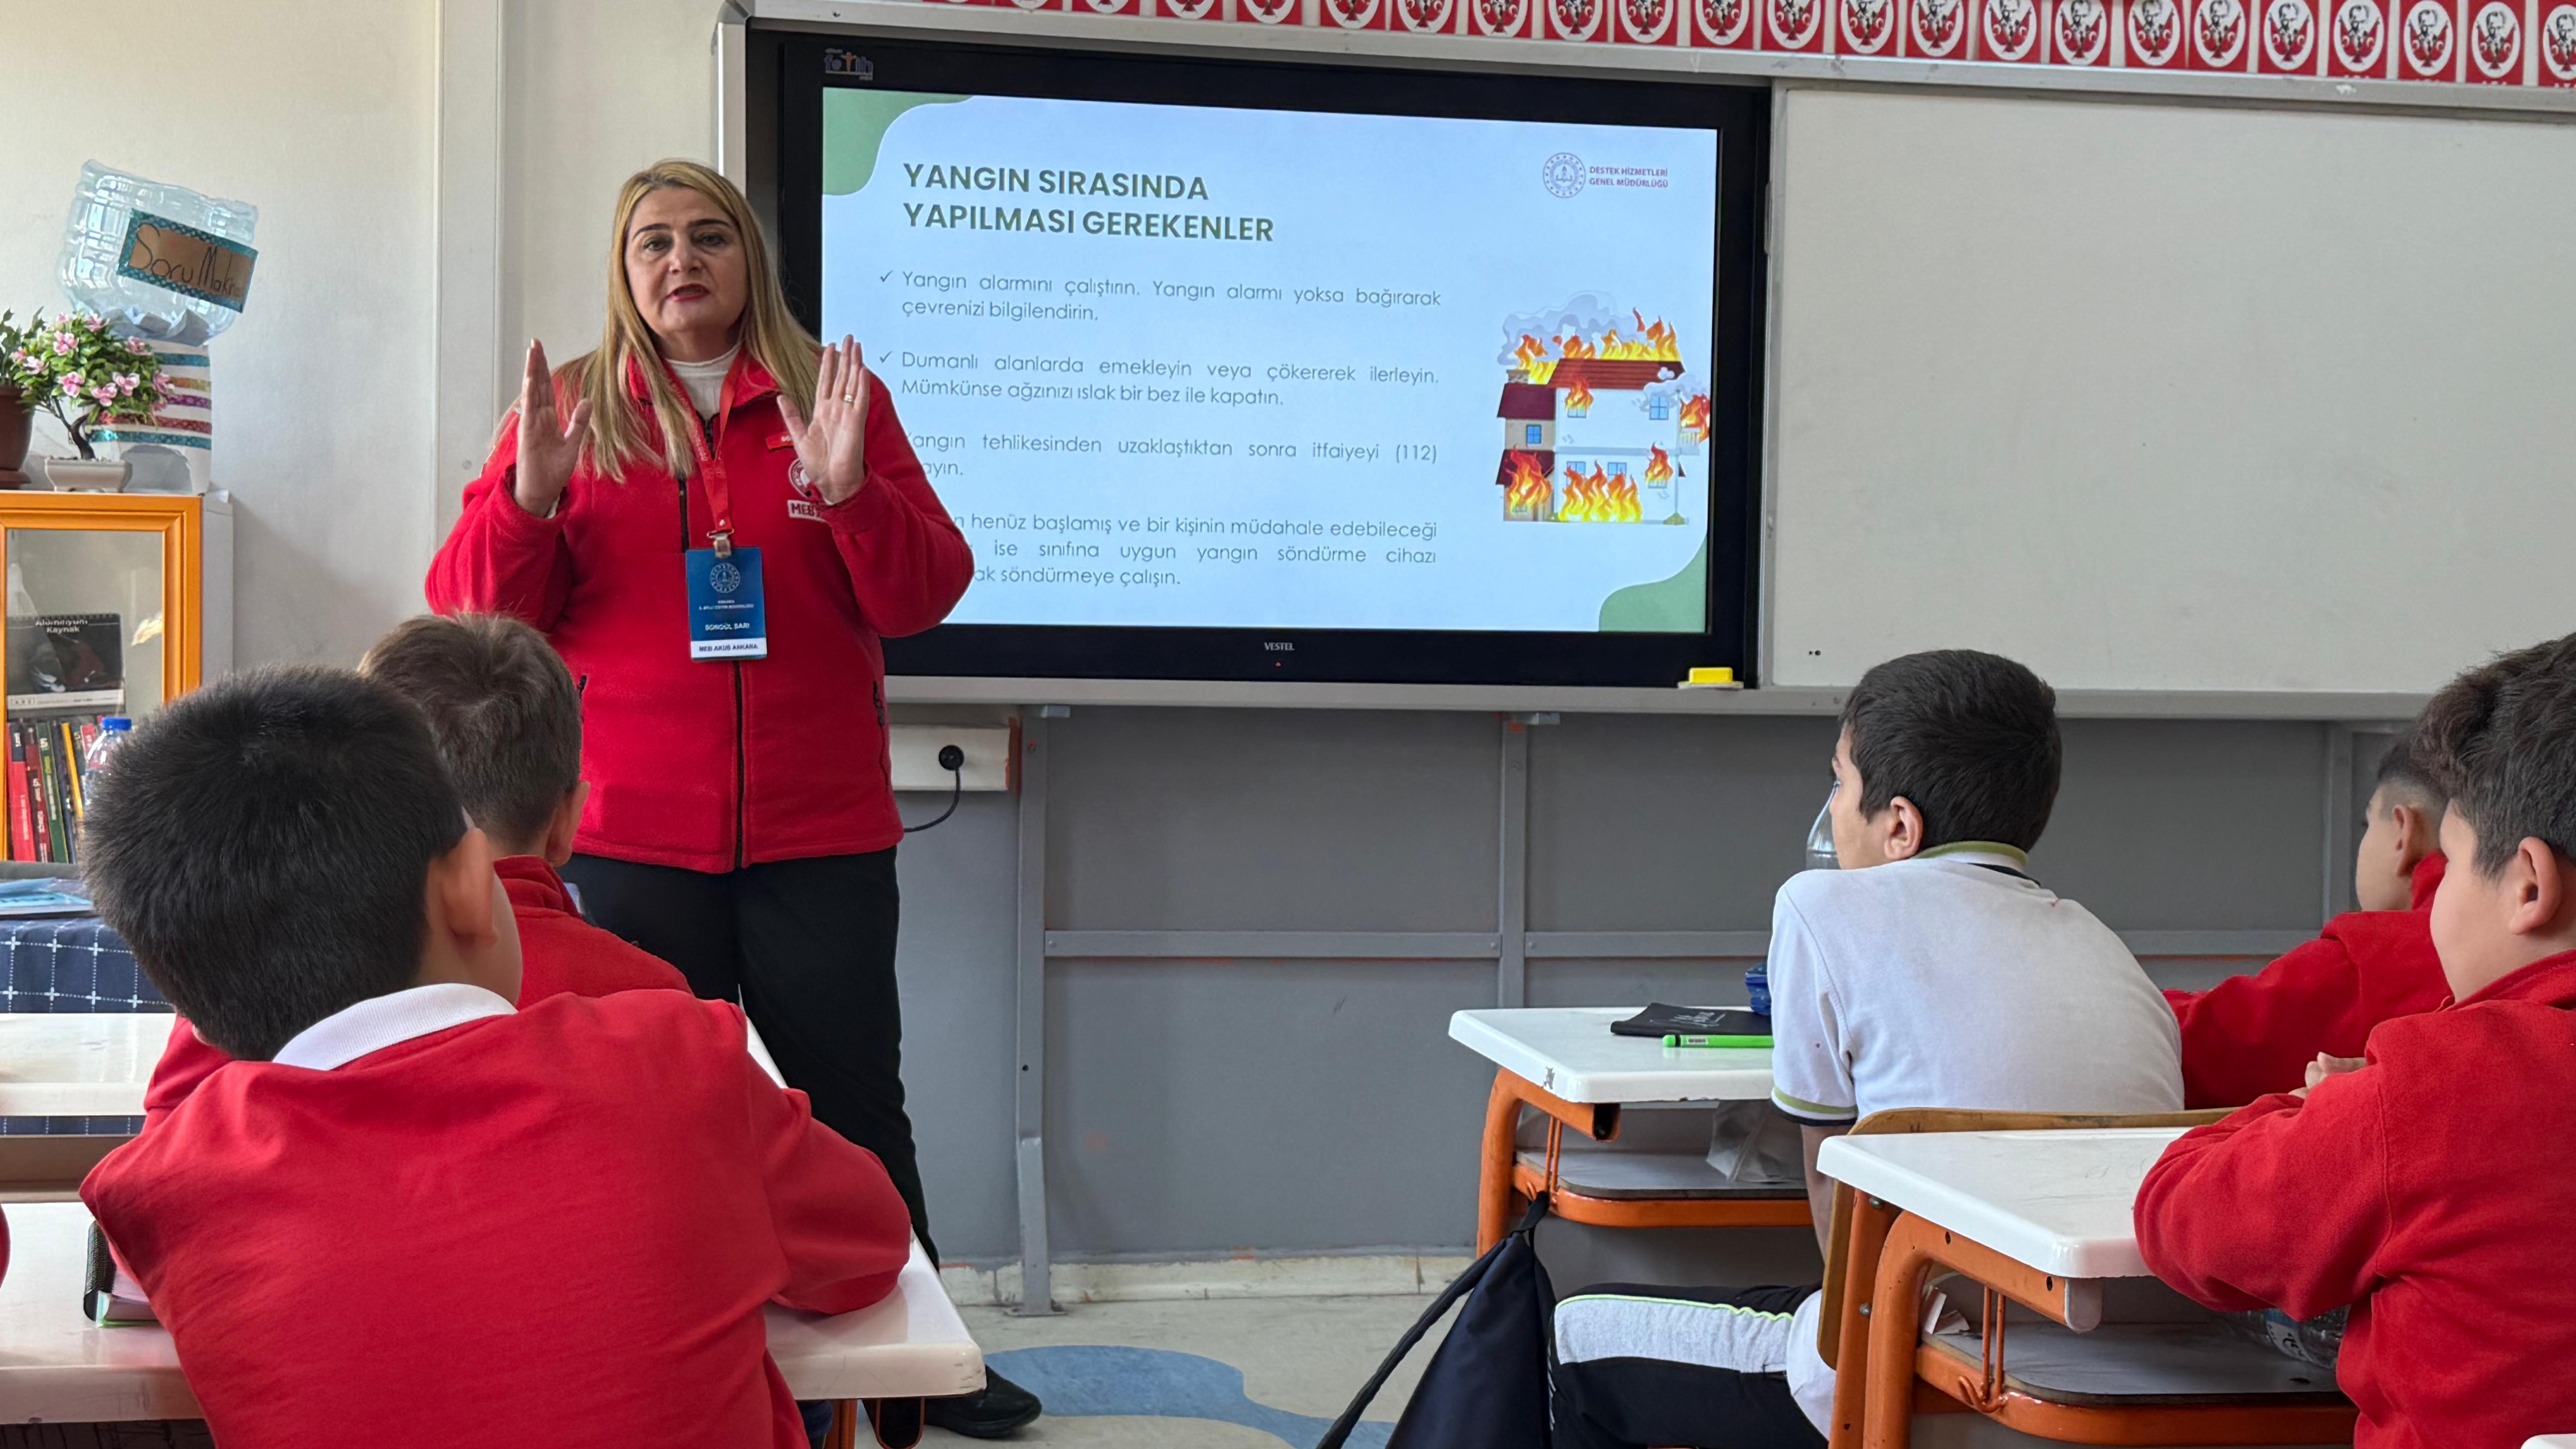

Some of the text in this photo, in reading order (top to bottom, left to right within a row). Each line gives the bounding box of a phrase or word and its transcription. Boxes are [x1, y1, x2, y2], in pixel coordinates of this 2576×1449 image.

[903, 163, 1209, 201] YANGIN SIRASINDA
[1589, 166, 1668, 177] DESTEK HİZMETLERİ
[1589, 178, 1668, 188] GENEL MÜDÜRLÜĞÜ
[903, 202, 1273, 242] YAPILMASI GEREKENLER
[128, 222, 193, 283] Soru
[903, 271, 1441, 308] Yangın alarmını çalıştırın. Yangın alarmı yoksa bağırarak
[902, 300, 1098, 322] çevrenizi bilgilendirin.
[902, 351, 1438, 386] Dumanlı alanlarda emekleyin veya çökererek ilerleyin.
[902, 379, 1283, 407] Mümkünse ağzınızı ıslak bir bez ile kapatın.
[909, 432, 1436, 464] angın tehlikesinden uzaklaştıktan sonra itfaiyeyi (112)
[922, 462, 963, 478] ayın.
[972, 513, 1026, 530] henüz
[1033, 514, 1111, 535] başlamış
[1118, 520, 1140, 532] ve
[1147, 517, 1170, 532] bir
[1176, 517, 1225, 536] kişinin
[1231, 519, 1324, 535] müdahale
[1330, 521, 1437, 541] edebileceği
[995, 539, 1436, 564] ise sınıfına uygun yangın söndürme cihazı
[1001, 567, 1114, 587] söndürmeye
[1120, 569, 1180, 588] çalışın.
[1264, 642, 1295, 651] VESTEL
